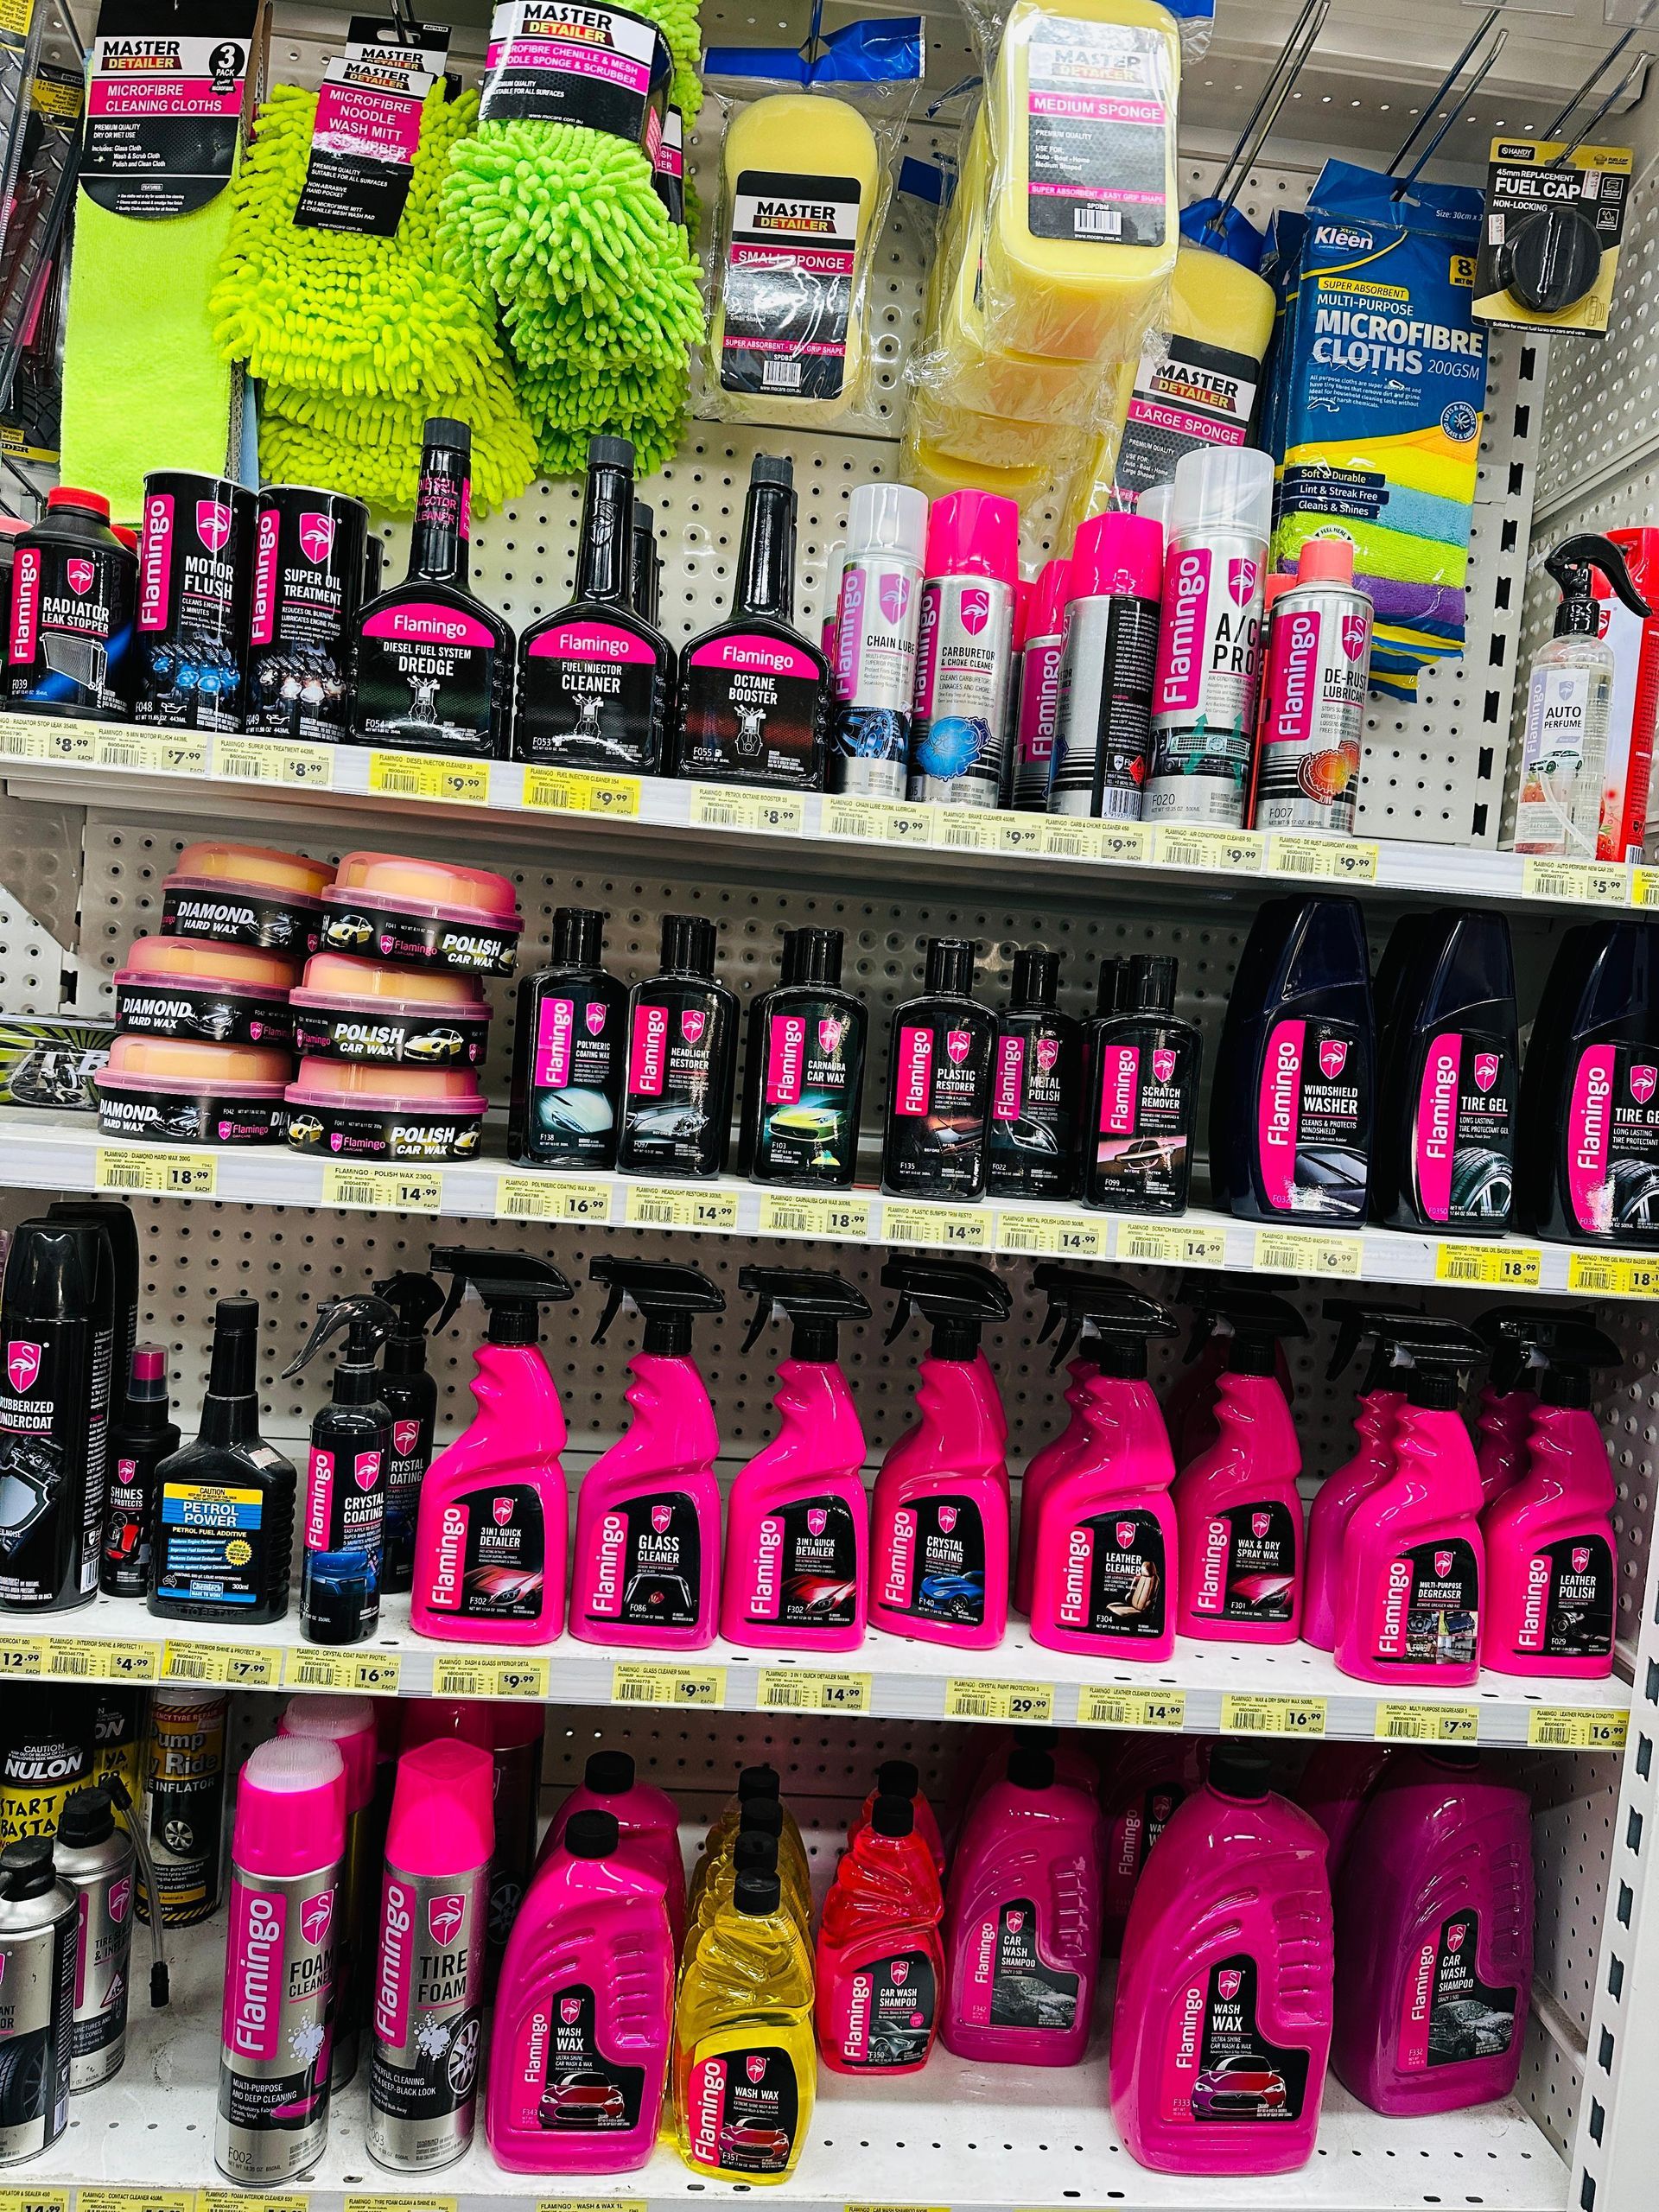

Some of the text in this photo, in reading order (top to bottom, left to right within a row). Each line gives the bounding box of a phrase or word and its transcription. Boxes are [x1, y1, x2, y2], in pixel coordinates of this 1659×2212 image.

[524, 4, 612, 30] MASTER
[529, 22, 607, 42] DETAILER
[103, 41, 180, 55] MASTER
[108, 58, 174, 69] DETAILER
[219, 46, 236, 67] 3
[553, 47, 638, 75] CHENILLE MESH
[533, 57, 636, 85] SPONGE SCRUBBER
[107, 85, 183, 96] MICROFIBRE
[105, 99, 221, 111] CLEANING CLOTHS
[329, 90, 411, 113] MICROFIBRE
[1034, 99, 1161, 119] MEDIUM SPONGE
[340, 105, 396, 125] NOODLE
[329, 118, 402, 141] WASH MITT
[1497, 168, 1574, 182] 45mm REPLACEMENT
[1496, 177, 1581, 199] FUEL CAP
[757, 201, 836, 219] MASTER
[1493, 200, 1548, 212] NON-LOCKING
[760, 219, 829, 231] DETAILER
[1314, 227, 1373, 250] Kleen
[1324, 280, 1406, 298] SUPER ABSORBENT
[1317, 294, 1414, 316] MULTI-PURPOSE
[1315, 310, 1484, 358] MICROFIBRE
[1314, 337, 1479, 379] CLOTHS 200GSM
[1156, 365, 1238, 396] MASTER
[1157, 380, 1230, 409] DETAILER
[1135, 405, 1239, 444] LARGE SPONGE
[1300, 485, 1378, 499] Lint Streak Free
[1299, 500, 1369, 516] Cleans Shines
[141, 500, 170, 624] Flamingo
[185, 556, 233, 581] MOTOR
[284, 569, 341, 590] SUPER OIL
[184, 577, 232, 600] FLUSH
[283, 585, 341, 605] TREATMENT
[14, 553, 37, 658] Flamingo
[42, 598, 109, 620] RADIATOR
[42, 613, 109, 633] LEAK STOPPER
[394, 615, 467, 637] Flamingo
[1164, 556, 1205, 702] Flamingo
[559, 634, 629, 656] Flamingo
[867, 635, 896, 650] CHAIN
[383, 641, 471, 660] DIESEL FUEL SYSTEM
[723, 645, 793, 669] Flamingo
[398, 658, 454, 677] DREDGE
[562, 662, 622, 675] FUEL INJECTOR
[734, 675, 775, 690] OCTANE
[1280, 617, 1315, 734] Flamingo
[12, 679, 28, 690] F039
[562, 675, 620, 694] CLEANER
[729, 689, 778, 705] BOOSTER
[1033, 652, 1061, 756] Flamingo
[1546, 707, 1581, 719] AUTO
[1544, 719, 1582, 728] PERFUME
[532, 737, 551, 746] F053
[693, 747, 712, 756] F055
[1152, 794, 1175, 805] F020
[177, 901, 254, 925] DIAMOND
[183, 919, 239, 936] HARD WAX
[442, 934, 502, 957] POLISH
[448, 952, 494, 969] CAR WAX
[671, 1048, 709, 1058] HEADLIGHT
[671, 1058, 709, 1070] RESTORER
[808, 1061, 846, 1071] CARNAUBA
[807, 1071, 845, 1084] CAR WAX
[938, 1069, 976, 1081] PLASTIC
[937, 1081, 975, 1092] RESTORER
[1143, 1087, 1180, 1097] SCRATCH
[1304, 1085, 1358, 1098] WINDSHIELD
[1029, 1090, 1060, 1102] POLISH
[1142, 1096, 1179, 1109] REMOVER
[1304, 1097, 1357, 1114] WASHER
[1461, 1096, 1508, 1112] TIRE GEL
[171, 1171, 208, 1185] 18.99
[335, 1167, 368, 1176] FLAMINGO
[569, 1198, 604, 1212] 16.99
[111, 1486, 143, 1499] SHINES
[183, 1502, 238, 1515] PETROL
[309, 1455, 333, 1547] Flamingo
[345, 1497, 384, 1509] CRYSTAL
[184, 1514, 236, 1526] POWER
[344, 1509, 383, 1523] COATING
[500, 1529, 522, 1537] QUICK
[480, 1536, 520, 1548] DETAILER
[639, 1535, 679, 1551] GLASS
[1238, 1539, 1281, 1550] WAX DRY
[432, 1509, 464, 1605] Flamingo
[638, 1550, 679, 1563] CLEANER
[1106, 1553, 1141, 1566] LEATHER
[1237, 1548, 1279, 1559] SPRAY WAX
[1106, 1563, 1141, 1575] CLEANER
[1560, 1575, 1596, 1586] LEATHER
[1418, 1589, 1461, 1599] DEGREASER
[1559, 1586, 1595, 1599] POLISH
[630, 1603, 646, 1611] F086
[1013, 1699, 1046, 1712] 29.99
[5, 1752, 83, 1779] NULON
[156, 1777, 214, 1792] INFLATOR
[420, 1949, 467, 1980] TIRE
[1442, 1955, 1460, 1967] CAR
[237, 1899, 280, 2050] Flamingo
[1440, 1967, 1465, 1979] WASH
[417, 1977, 466, 2003] FOAM
[880, 1988, 917, 1998] CAR WASH
[1439, 1979, 1473, 1992] SHAMPOO
[880, 1998, 916, 2007] SHAMPOO
[557, 2027, 581, 2037] WASH
[556, 2037, 583, 2051] WAX
[245, 2091, 296, 2102] DEEP CLEANING
[696, 2063, 724, 2160] Flamingo
[229, 2147, 251, 2164] F002
